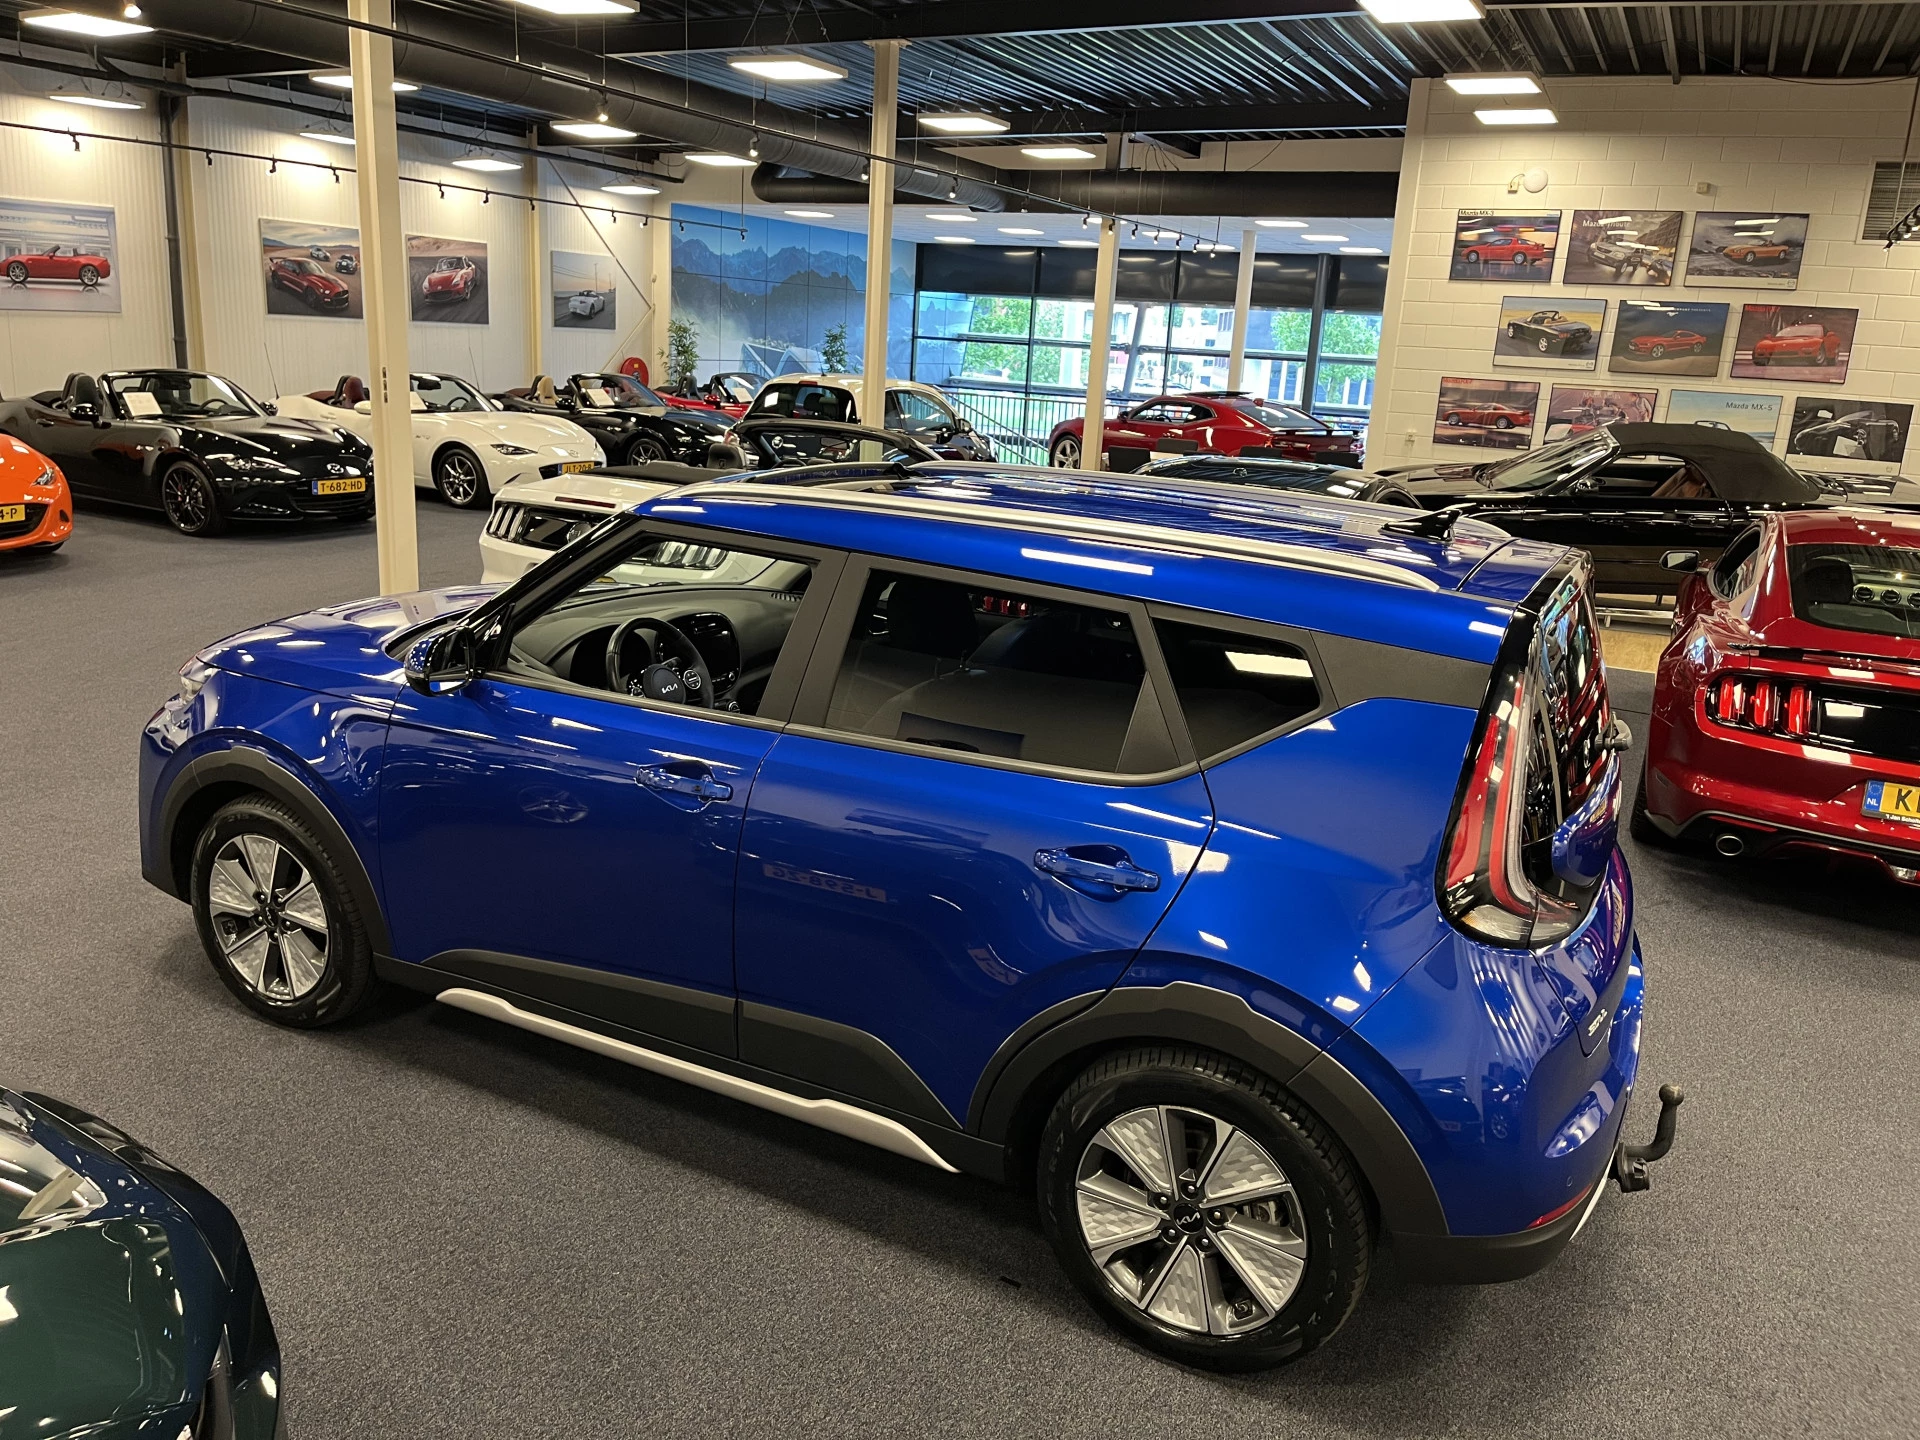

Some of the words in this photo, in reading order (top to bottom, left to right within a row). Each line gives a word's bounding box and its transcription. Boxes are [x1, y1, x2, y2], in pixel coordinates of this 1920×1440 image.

[320, 480, 363, 492] T-682-HD
[1866, 797, 1879, 806] NL
[1894, 788, 1920, 813] K
